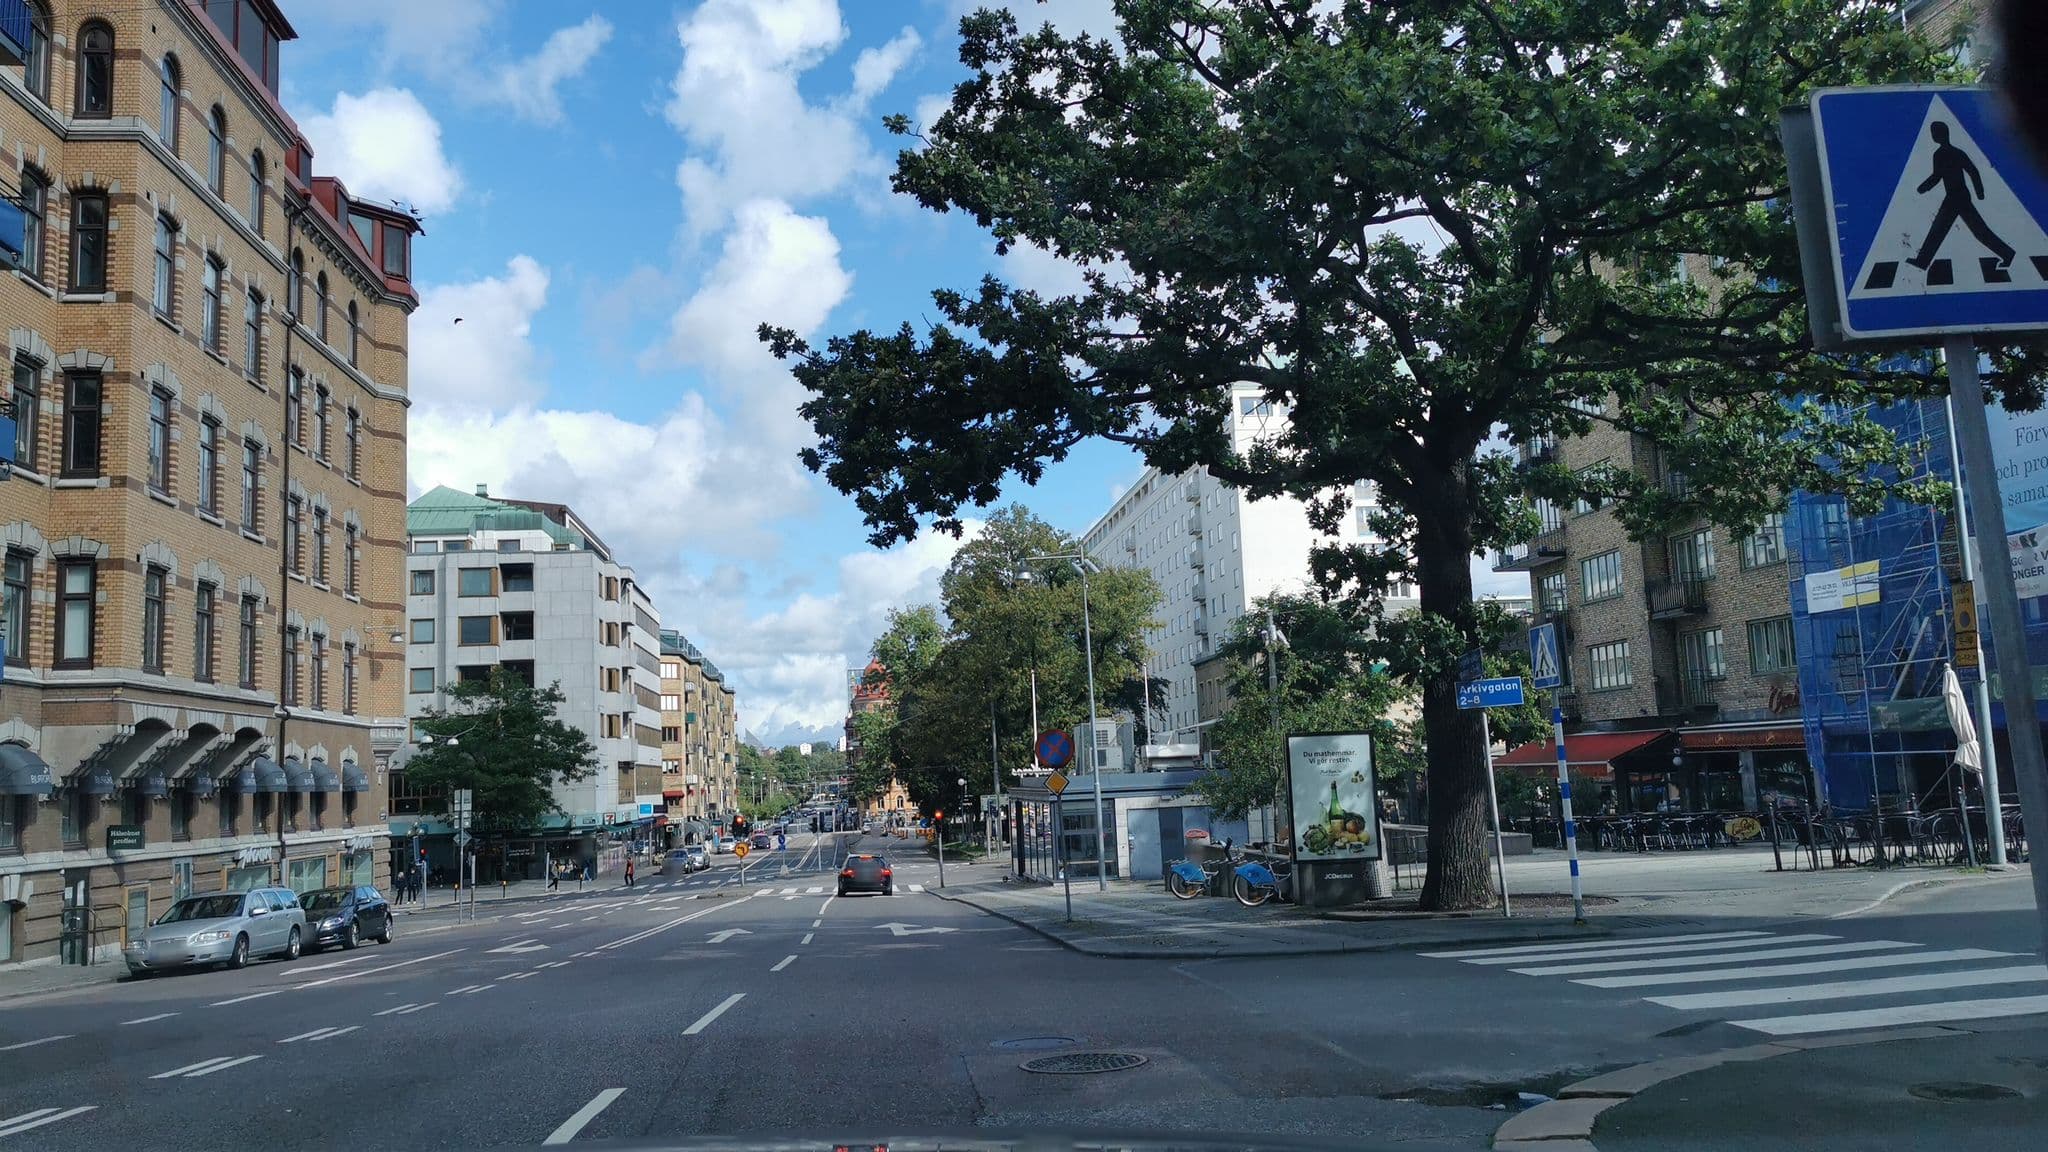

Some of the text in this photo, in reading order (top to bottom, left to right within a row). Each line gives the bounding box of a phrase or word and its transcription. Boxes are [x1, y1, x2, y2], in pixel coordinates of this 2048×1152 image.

[1995, 459, 2020, 480] och
[2008, 486, 2048, 507] sama
[2012, 565, 2045, 580] ONGER
[1460, 683, 1519, 694] Arkivgatan
[1460, 695, 1480, 705] 2-8
